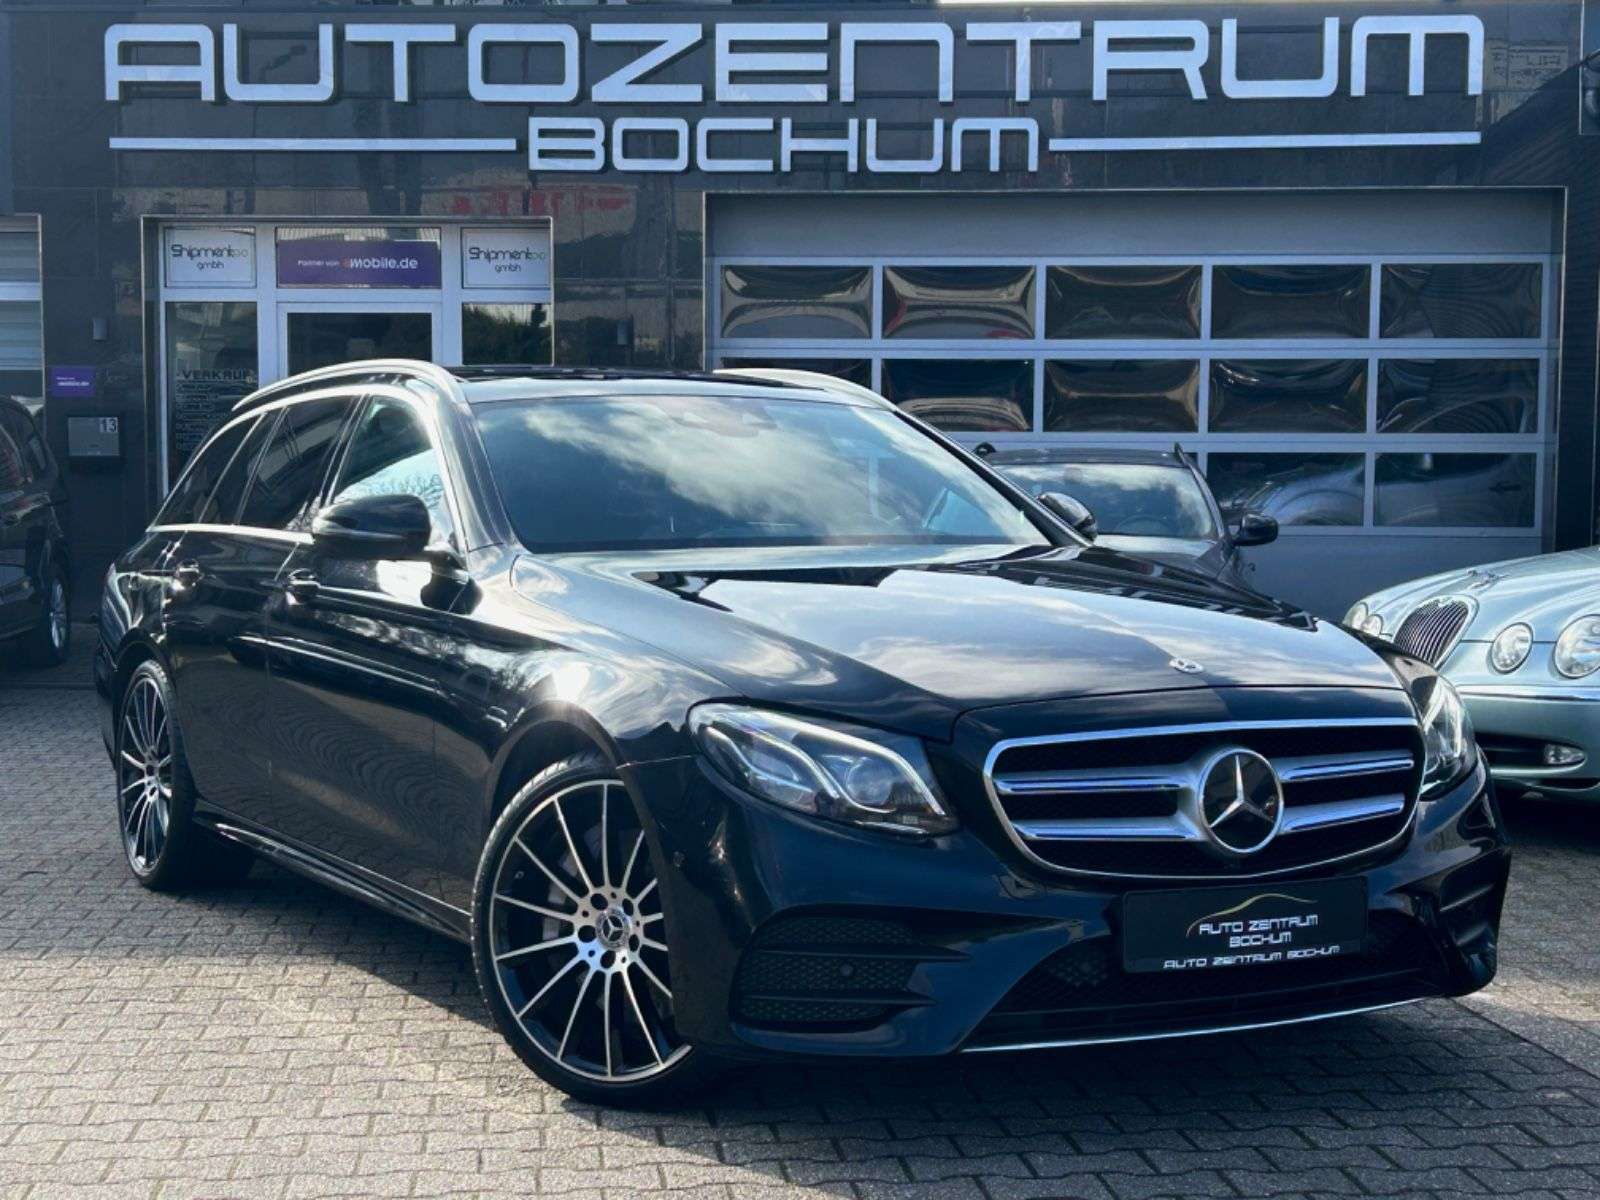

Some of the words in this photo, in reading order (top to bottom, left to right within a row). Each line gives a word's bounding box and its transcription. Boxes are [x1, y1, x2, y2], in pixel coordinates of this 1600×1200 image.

[104, 15, 1484, 103] AUTOZENTRUM
[528, 116, 1039, 172] BOCHUM
[350, 256, 419, 269] mobile.de
[102, 418, 117, 432] 13
[1199, 921, 1243, 936] AUTO
[1249, 914, 1319, 932] ZENTRUM
[1229, 931, 1292, 948] BOCHUM
[1163, 957, 1207, 969] AUTO
[1212, 952, 1282, 966] ZENTRUM
[1287, 945, 1340, 959] BOCHUM
